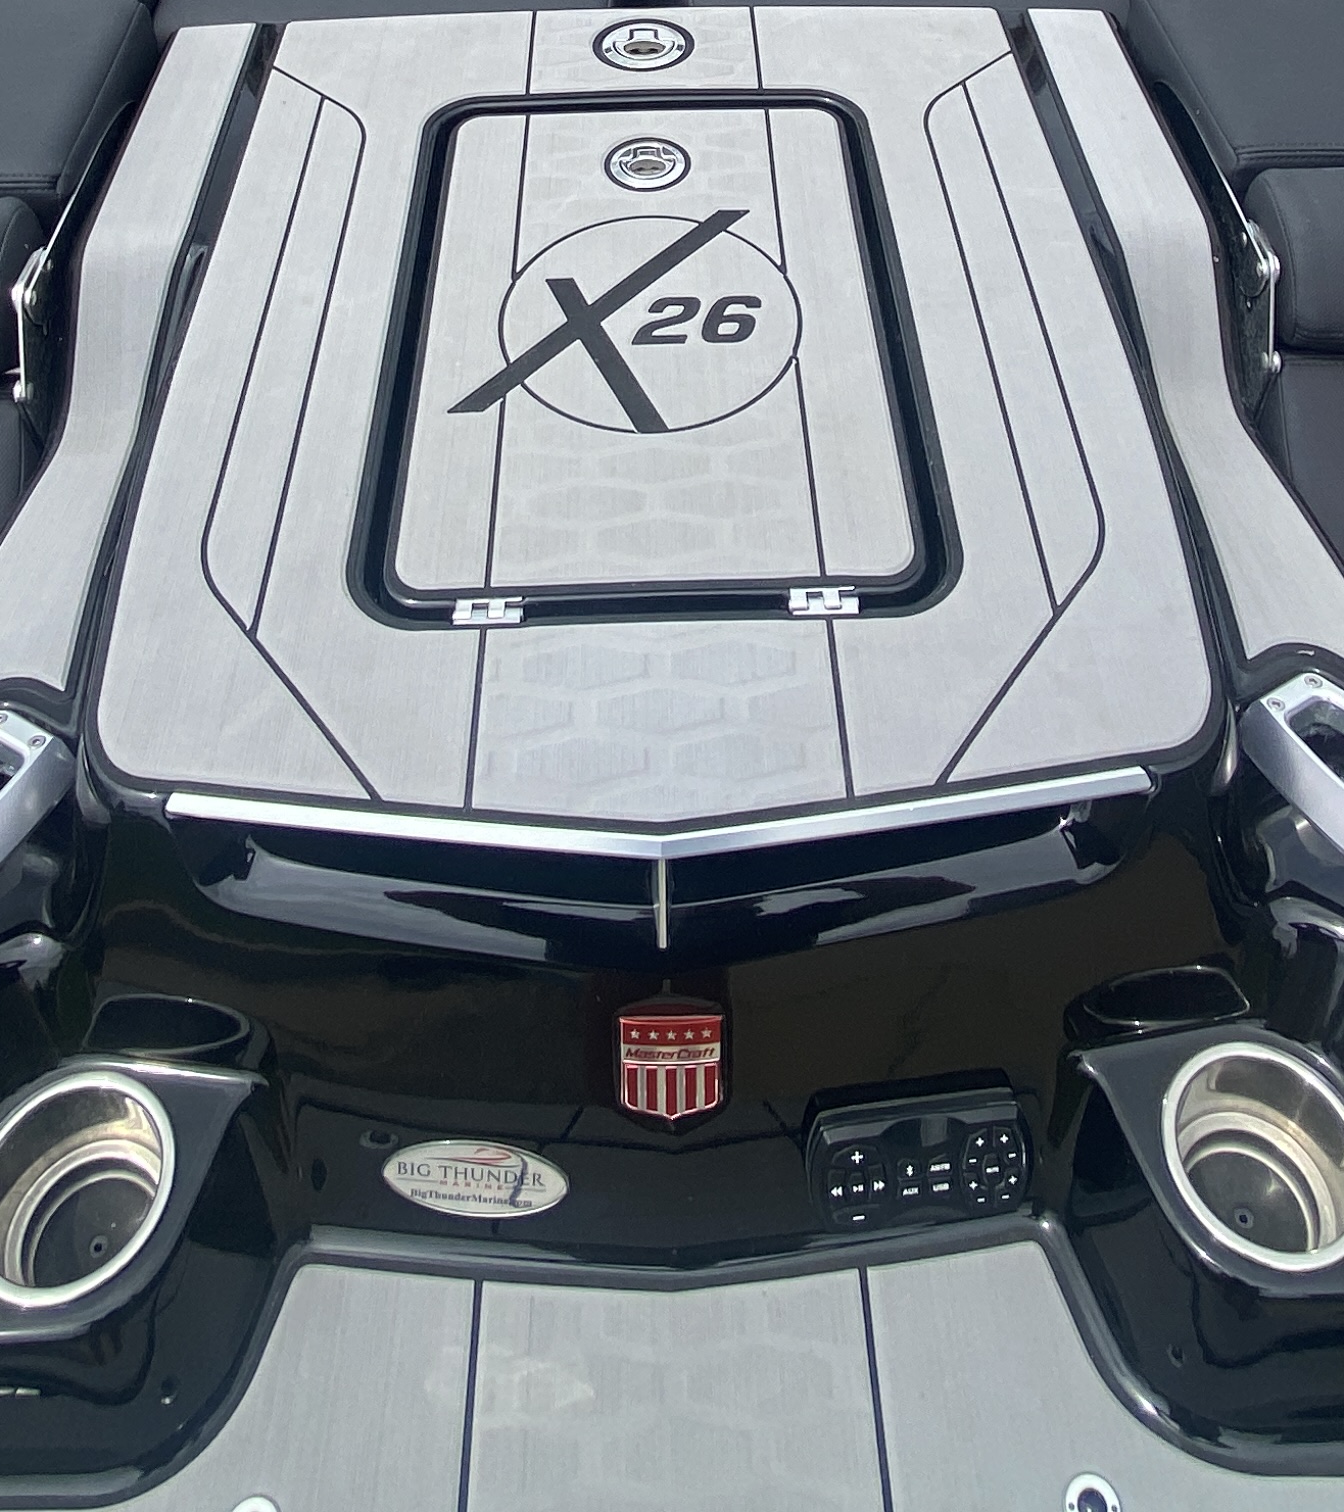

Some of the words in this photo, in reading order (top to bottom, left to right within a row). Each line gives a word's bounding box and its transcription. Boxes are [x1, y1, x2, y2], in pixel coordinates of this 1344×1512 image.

[625, 1047, 716, 1060] MasterCraft
[397, 1161, 431, 1177] BIG
[438, 1165, 546, 1187] THUNDER
[440, 1179, 506, 1191] MARINE
